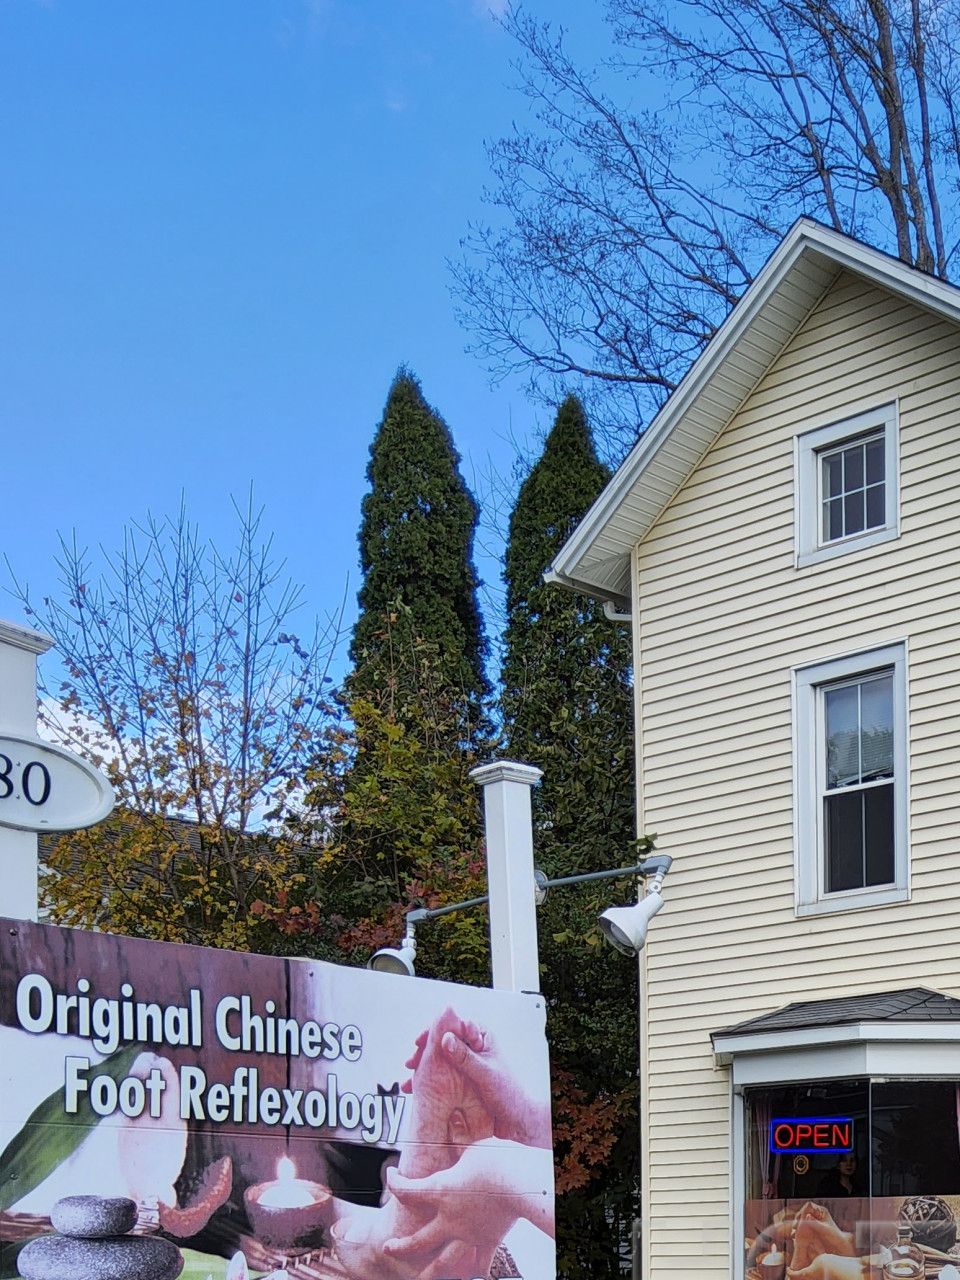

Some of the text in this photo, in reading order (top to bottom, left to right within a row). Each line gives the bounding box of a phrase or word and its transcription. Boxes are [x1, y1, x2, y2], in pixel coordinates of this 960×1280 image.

[16, 973, 363, 1061] Original Chinese
[64, 1056, 405, 1144] Foot Reflexology
[774, 1123, 850, 1147] OPEN
